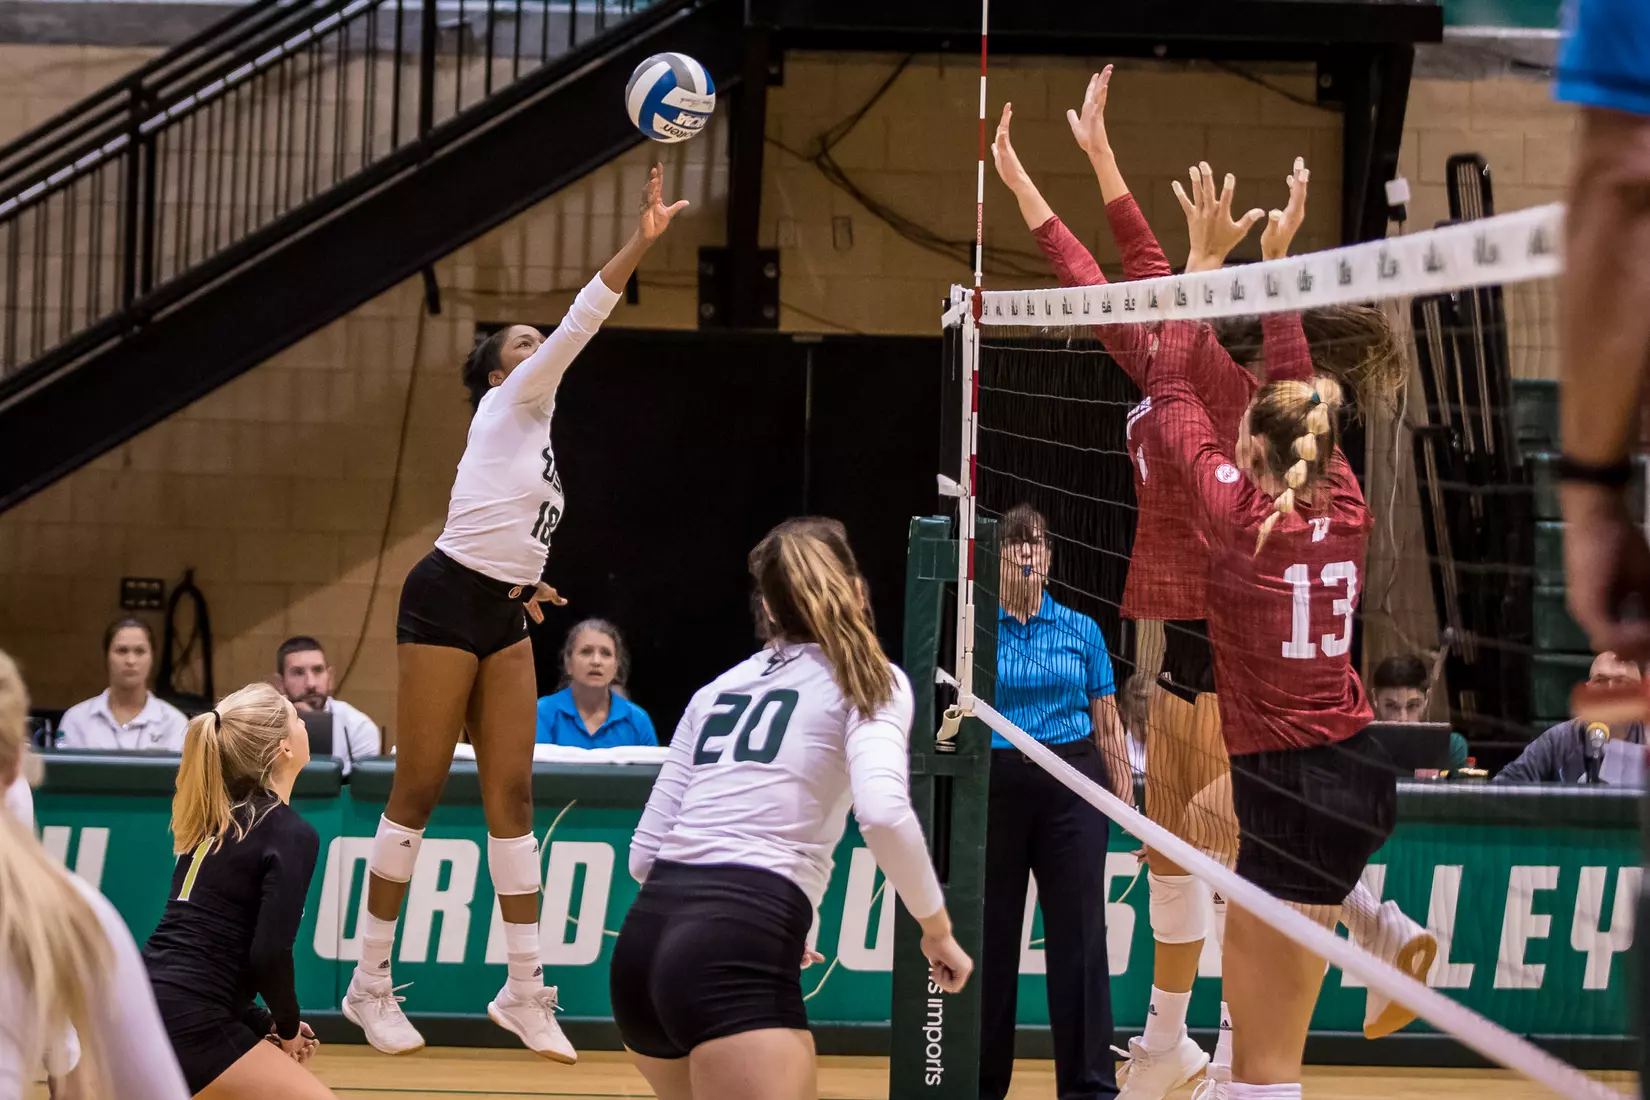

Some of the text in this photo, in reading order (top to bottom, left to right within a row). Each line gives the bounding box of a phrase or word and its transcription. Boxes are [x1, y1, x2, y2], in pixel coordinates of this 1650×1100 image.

[530, 501, 561, 546] 18
[1281, 560, 1358, 659] 13
[693, 688, 800, 765] 20
[177, 836, 216, 901] 1
[922, 998, 944, 1086] imports
